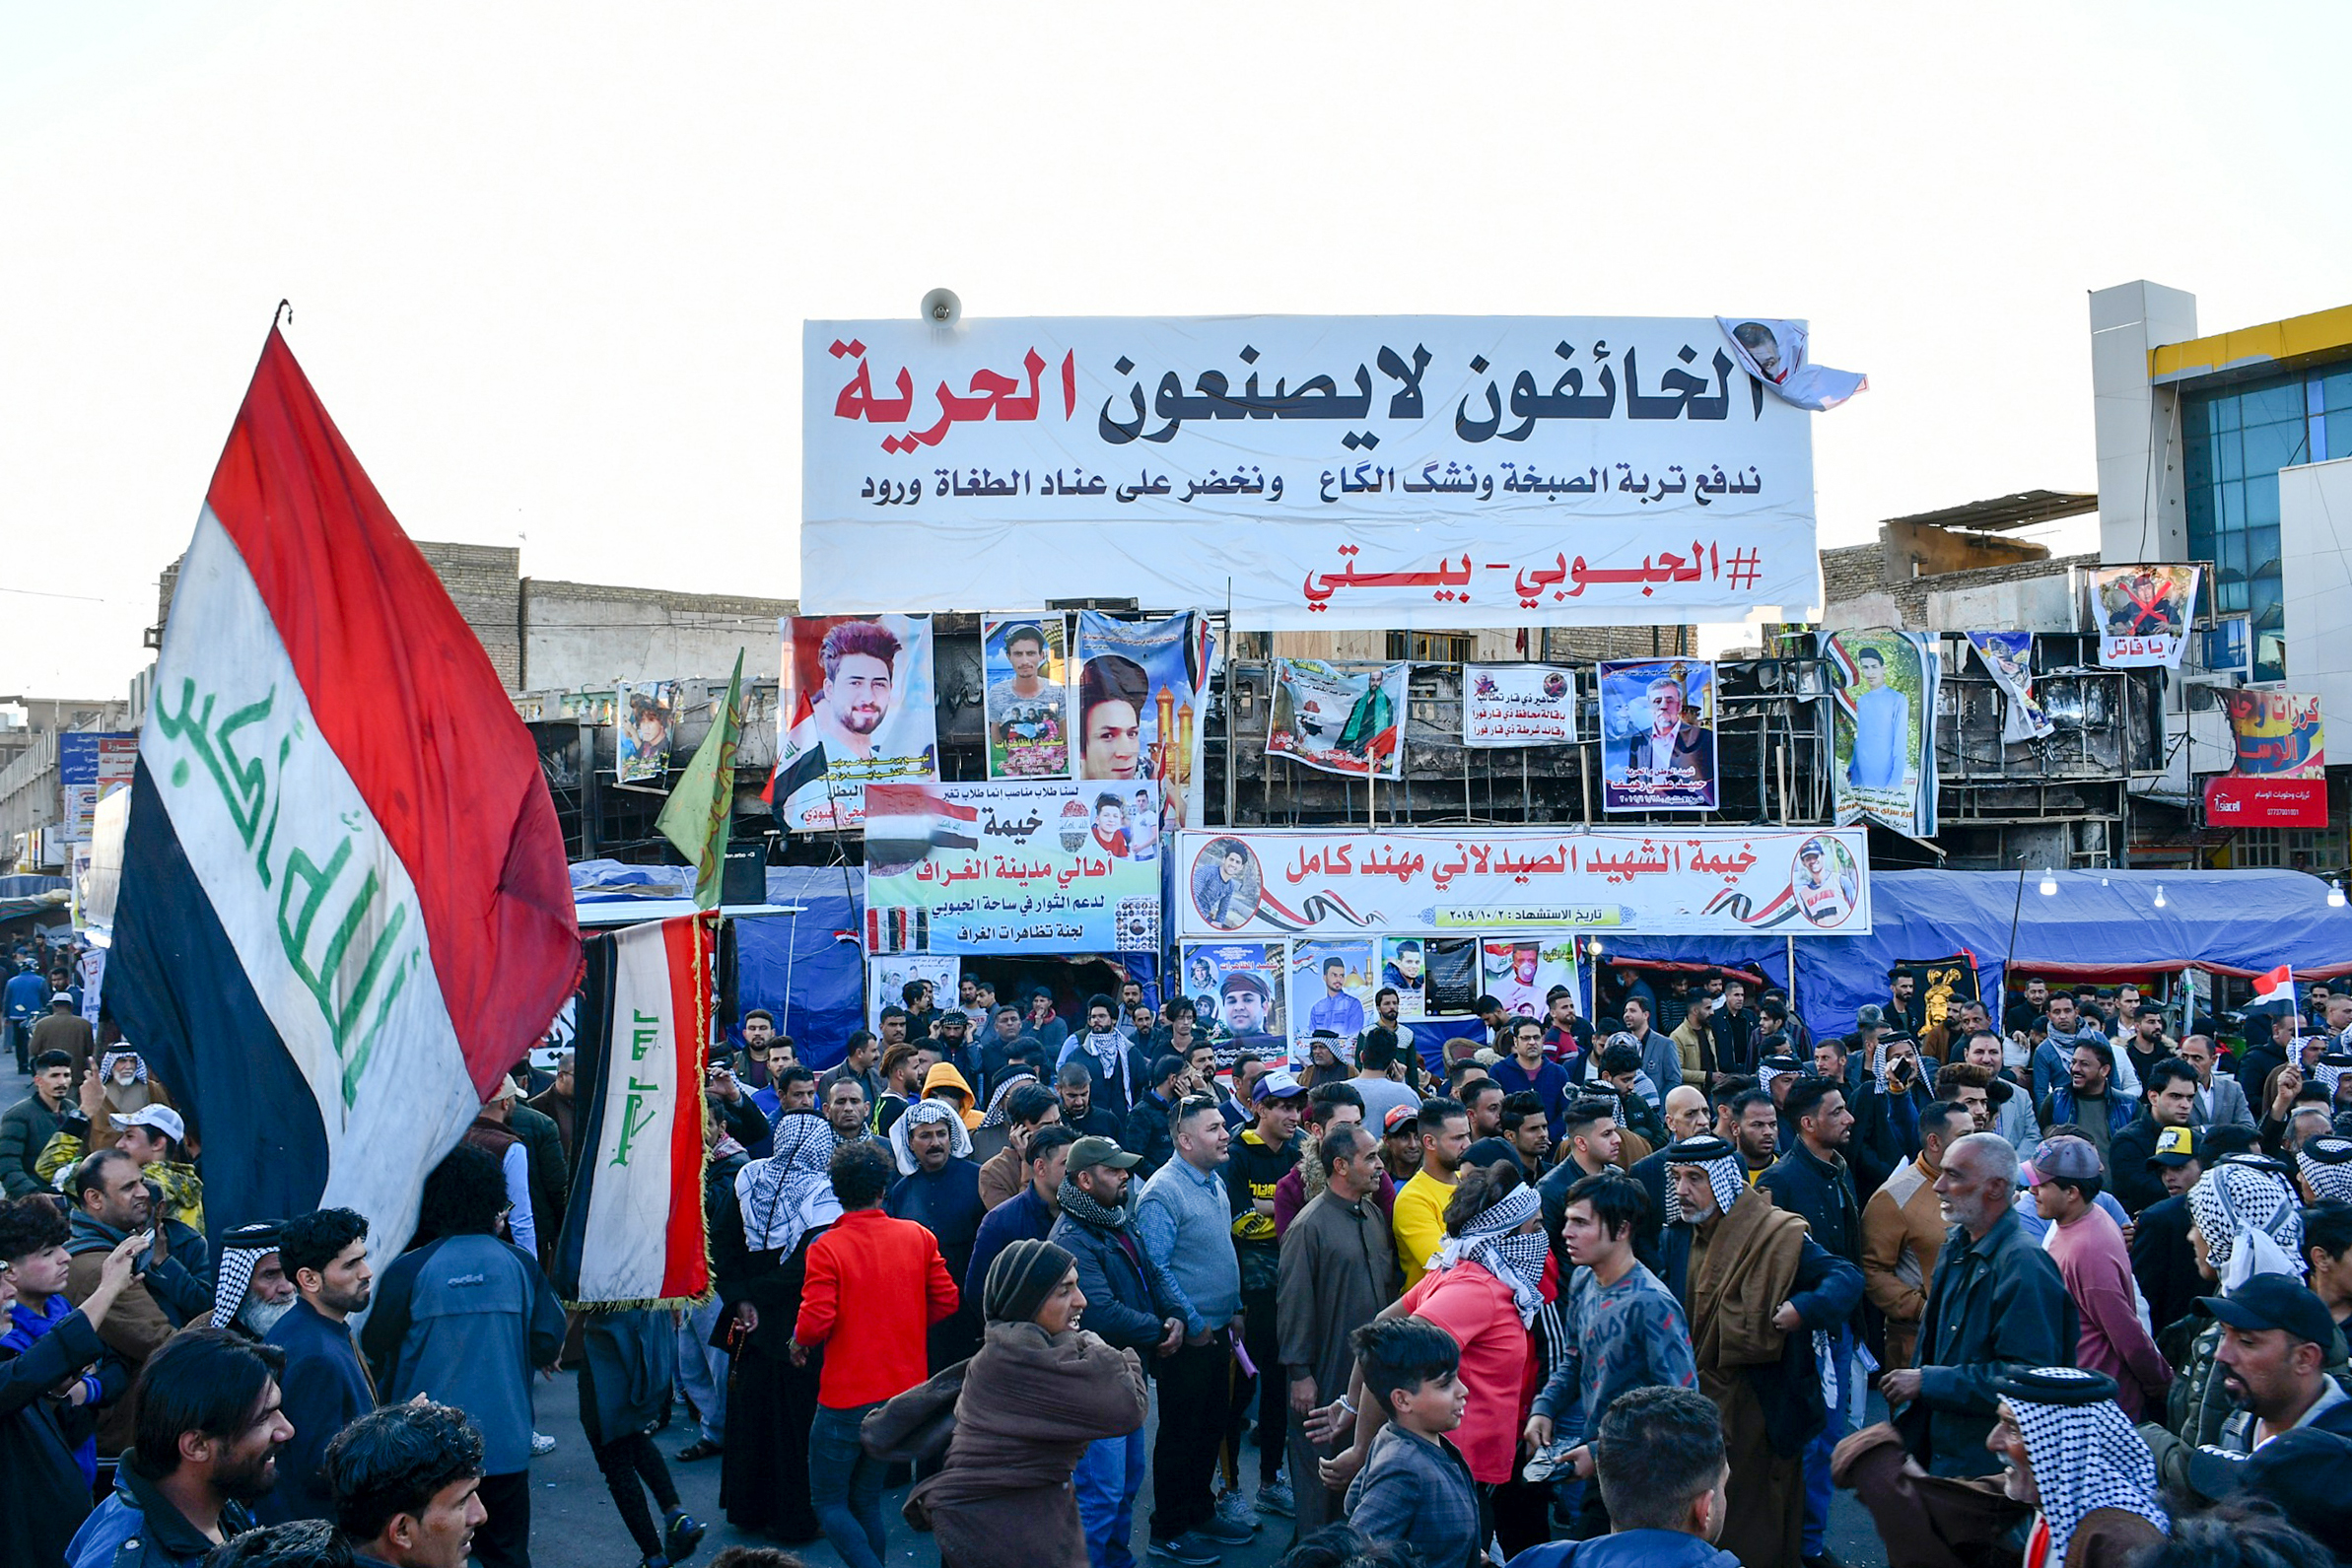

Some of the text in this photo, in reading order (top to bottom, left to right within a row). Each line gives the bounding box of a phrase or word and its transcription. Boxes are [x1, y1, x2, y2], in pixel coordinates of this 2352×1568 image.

[828, 338, 1075, 455] الحرية
[1455, 340, 1764, 443] الخائفون
[934, 468, 1030, 497] الطغاة
[1041, 465, 1107, 496] عناد
[1177, 465, 1282, 503] ونخضر
[1502, 462, 1609, 493] الصبخة
[1618, 462, 1687, 505] تربة
[1694, 464, 1761, 506] ندفع
[862, 475, 921, 506] ورود
[1116, 470, 1171, 503] على
[2108, 639, 2143, 658] قاتل
[2148, 639, 2165, 658] يا
[1505, 693, 1519, 704] قار
[1522, 694, 1532, 706] ذي
[1487, 709, 1501, 719] قار
[1503, 708, 1512, 721] ذي
[1515, 710, 1540, 718] محافظ
[2272, 695, 2318, 730] كرزات
[1490, 724, 1503, 735] قار
[1505, 724, 1514, 737] ذي
[1517, 724, 1540, 735] شرطة
[1542, 726, 1564, 738] وقائد
[942, 787, 960, 801] تغير
[963, 787, 985, 799] طلاب
[1004, 788, 1033, 799] مناصب
[1035, 786, 1057, 799] طلاب
[1061, 786, 1078, 796] لسنا
[1648, 779, 1674, 793] علي
[1676, 781, 1707, 792] حميد
[983, 807, 1044, 846] خيمة
[916, 851, 1113, 890] أهالي مدينة الغراف
[1285, 839, 1758, 892] خيمة الشهيد الصيدلاني مهند كامل
[932, 894, 1104, 919] لدعم الثوار في ساحة الحبوبي
[1515, 909, 1571, 920] الاستشهاد
[1575, 909, 1602, 922] تاريخ
[957, 924, 1083, 943] لجنة تظاهرات الغراف
